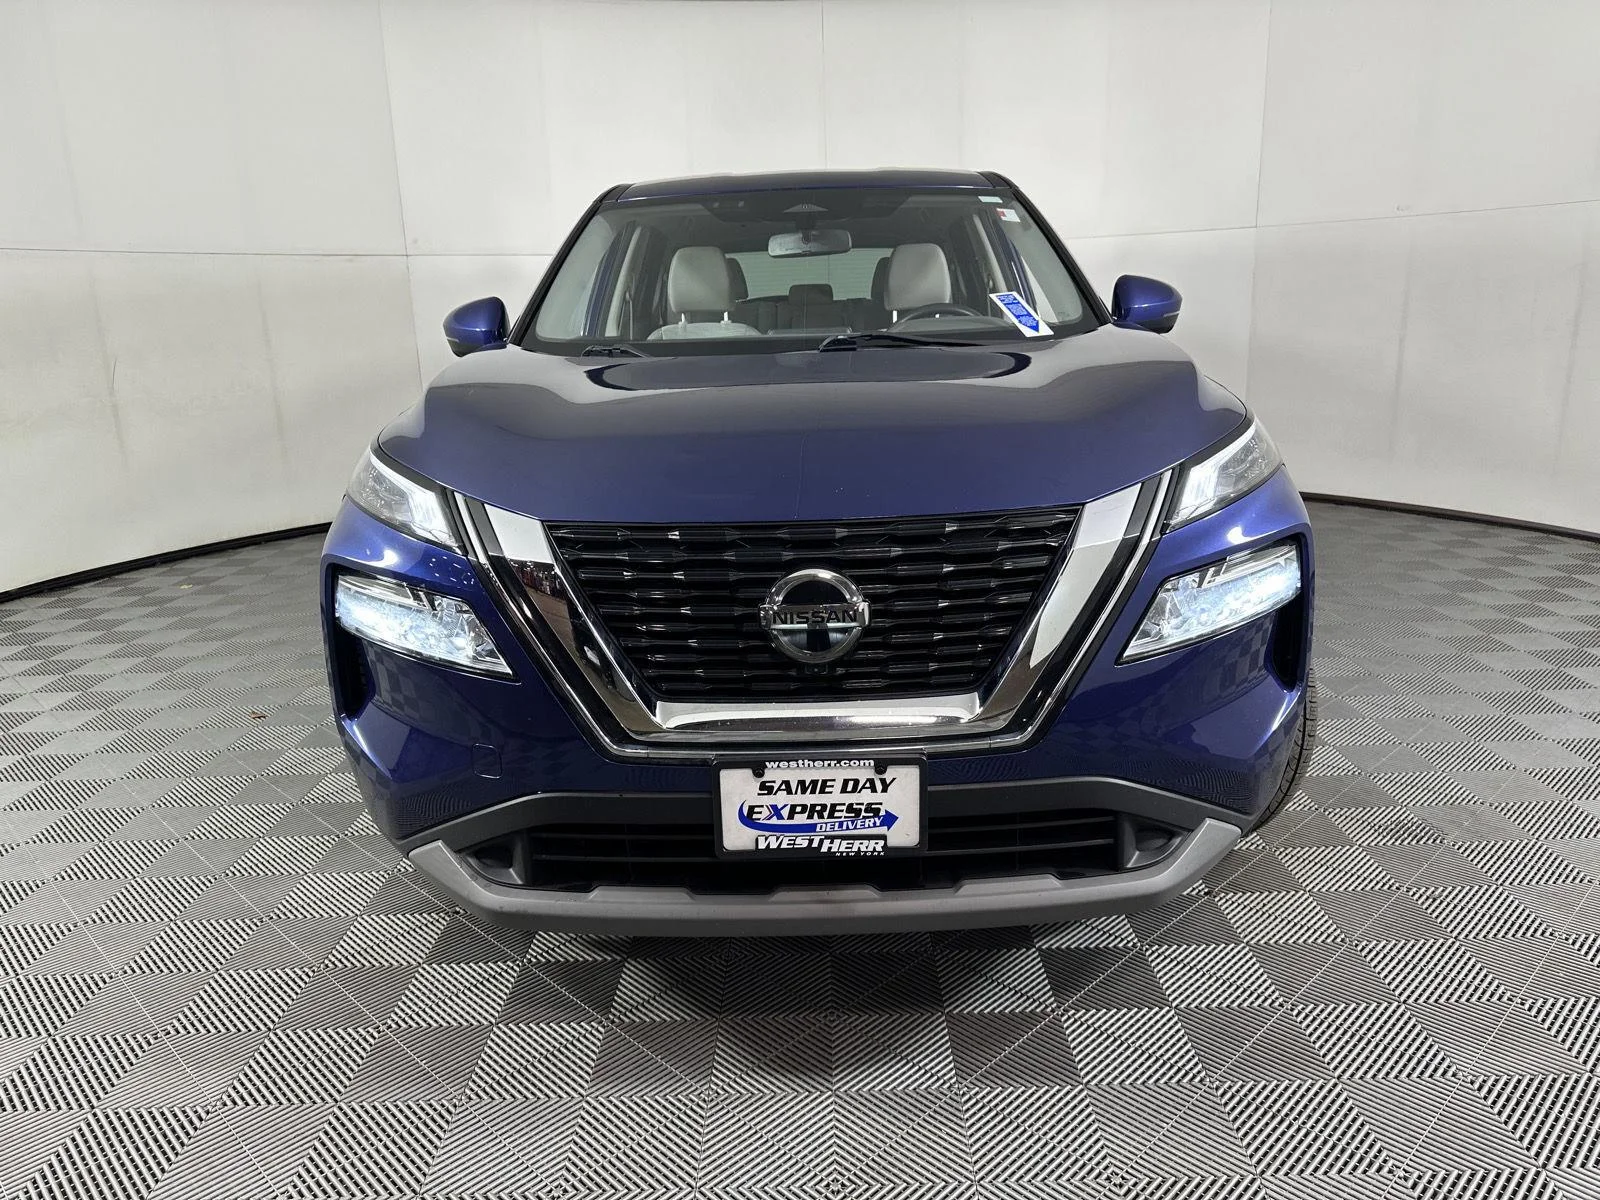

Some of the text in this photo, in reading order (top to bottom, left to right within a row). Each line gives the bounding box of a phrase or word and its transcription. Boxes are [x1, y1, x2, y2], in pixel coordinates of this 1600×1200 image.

[772, 610, 857, 624] NISSAN
[765, 759, 874, 768] westherr.com
[757, 777, 897, 796] SAME DAY
[746, 802, 883, 821] EXPRESS
[815, 816, 884, 832] DELIVERY
